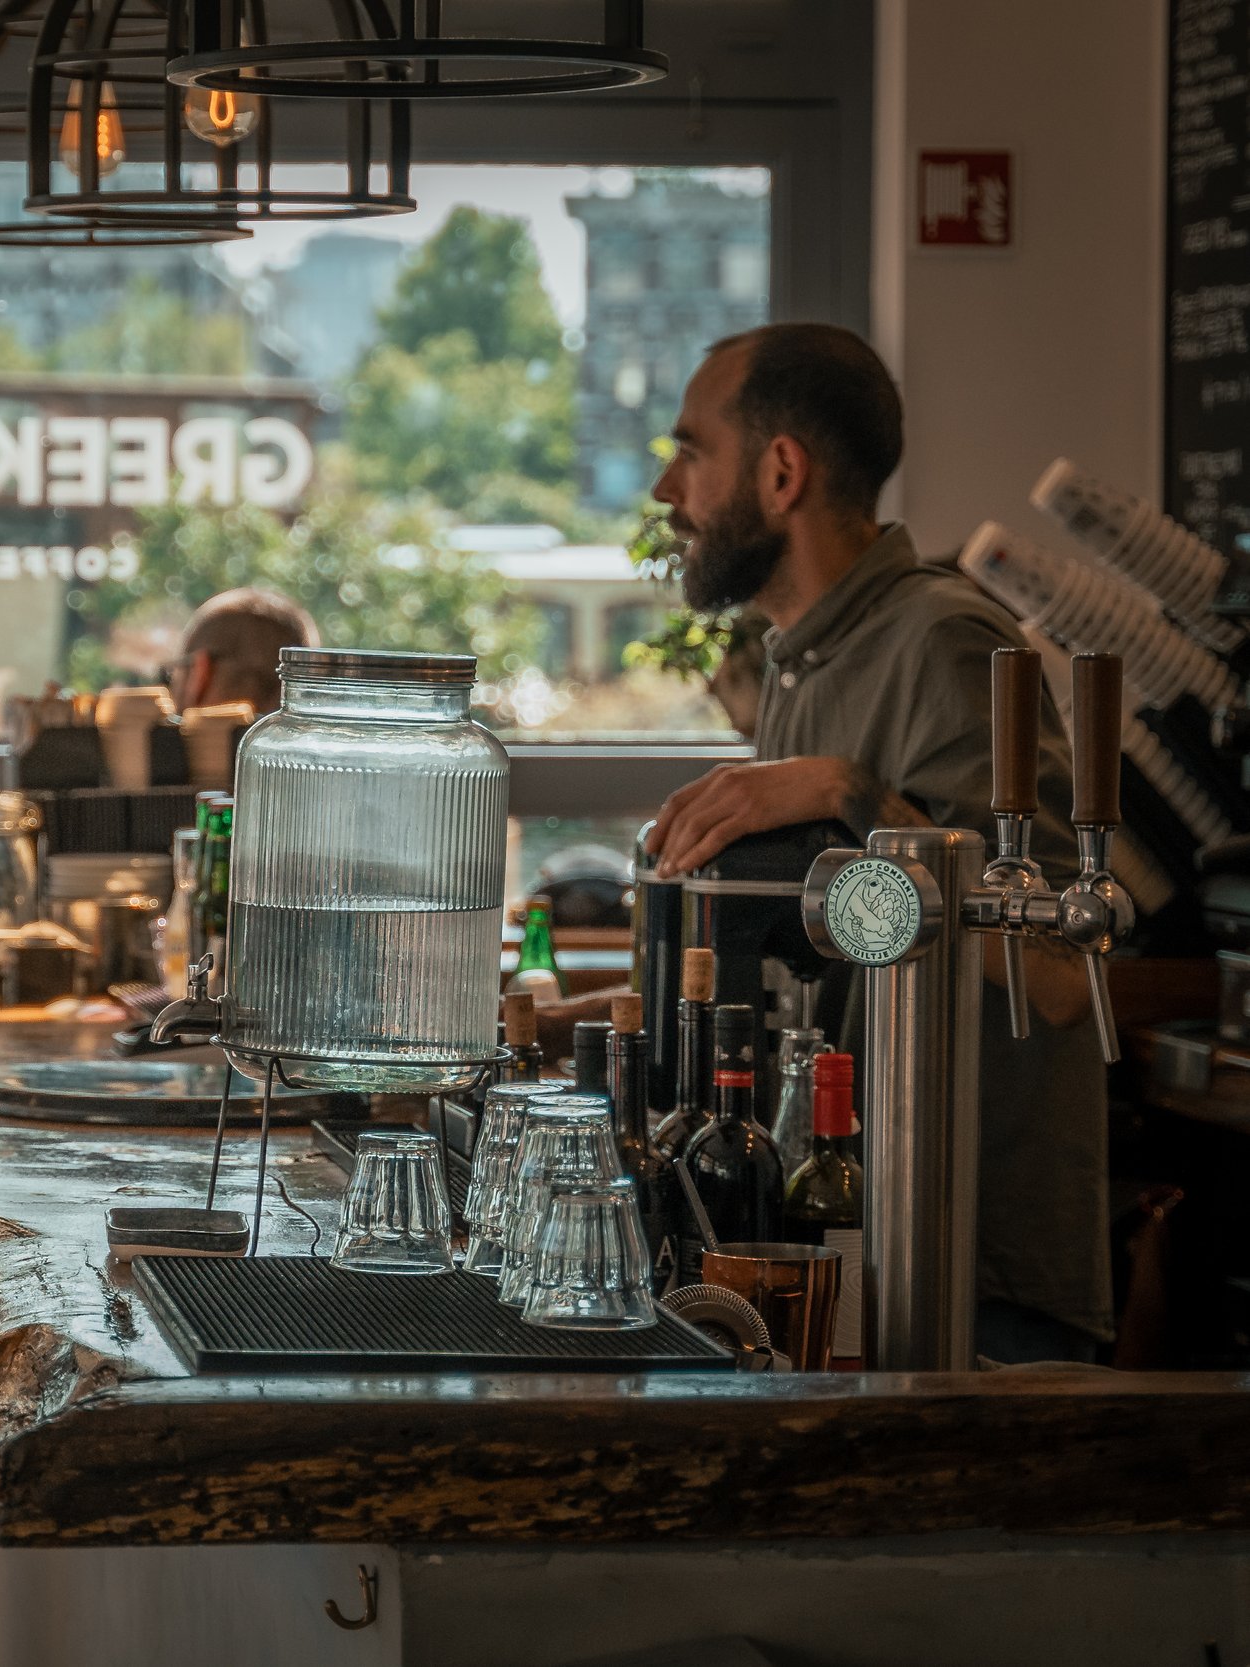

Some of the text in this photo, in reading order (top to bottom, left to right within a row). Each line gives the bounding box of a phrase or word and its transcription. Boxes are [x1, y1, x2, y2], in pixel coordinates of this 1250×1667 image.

[834, 862, 915, 899] BREWING COMPANY
[832, 925, 850, 950] 2012
[893, 908, 918, 954] HAARLEM
[853, 949, 890, 960] UILTJE
